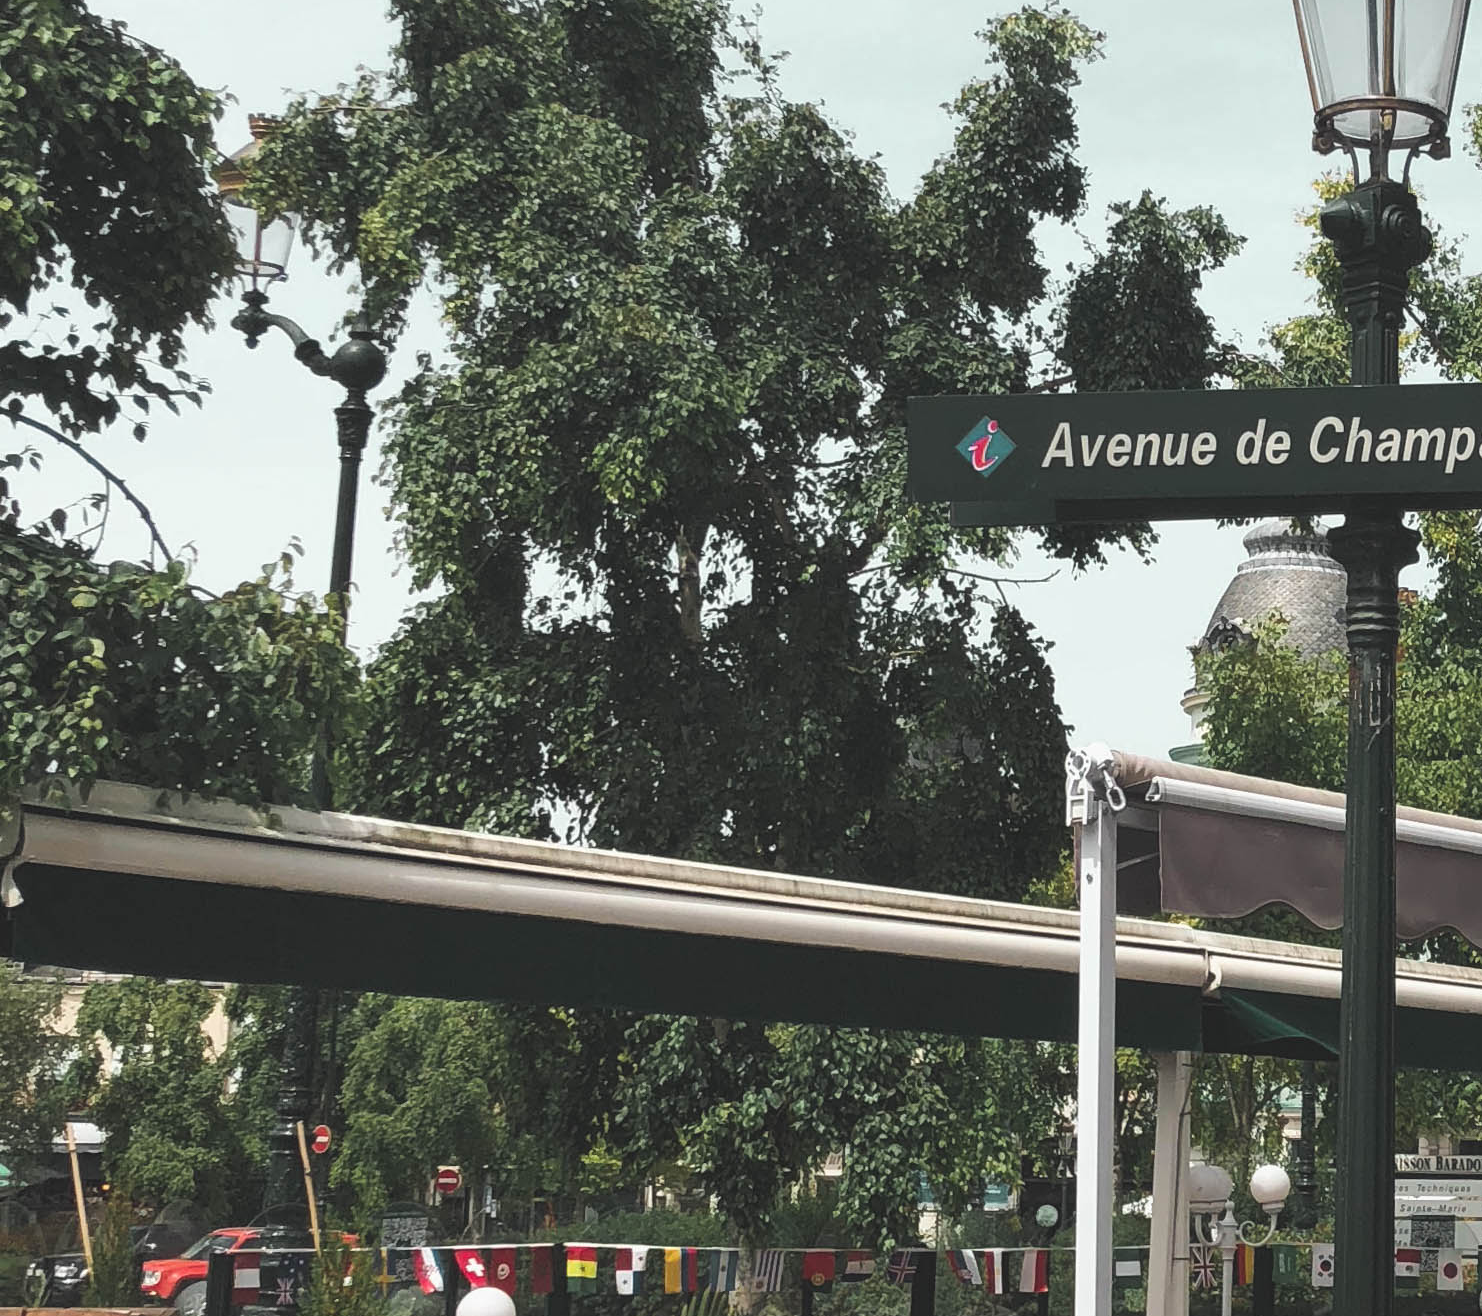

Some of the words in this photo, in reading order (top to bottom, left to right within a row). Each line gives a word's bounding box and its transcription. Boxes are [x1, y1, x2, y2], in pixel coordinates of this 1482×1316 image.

[1041, 422, 1217, 468] Avenue
[1236, 419, 1291, 465] de
[1394, 1157, 1431, 1172] ISSON
[1417, 1183, 1471, 1195] Techniques
